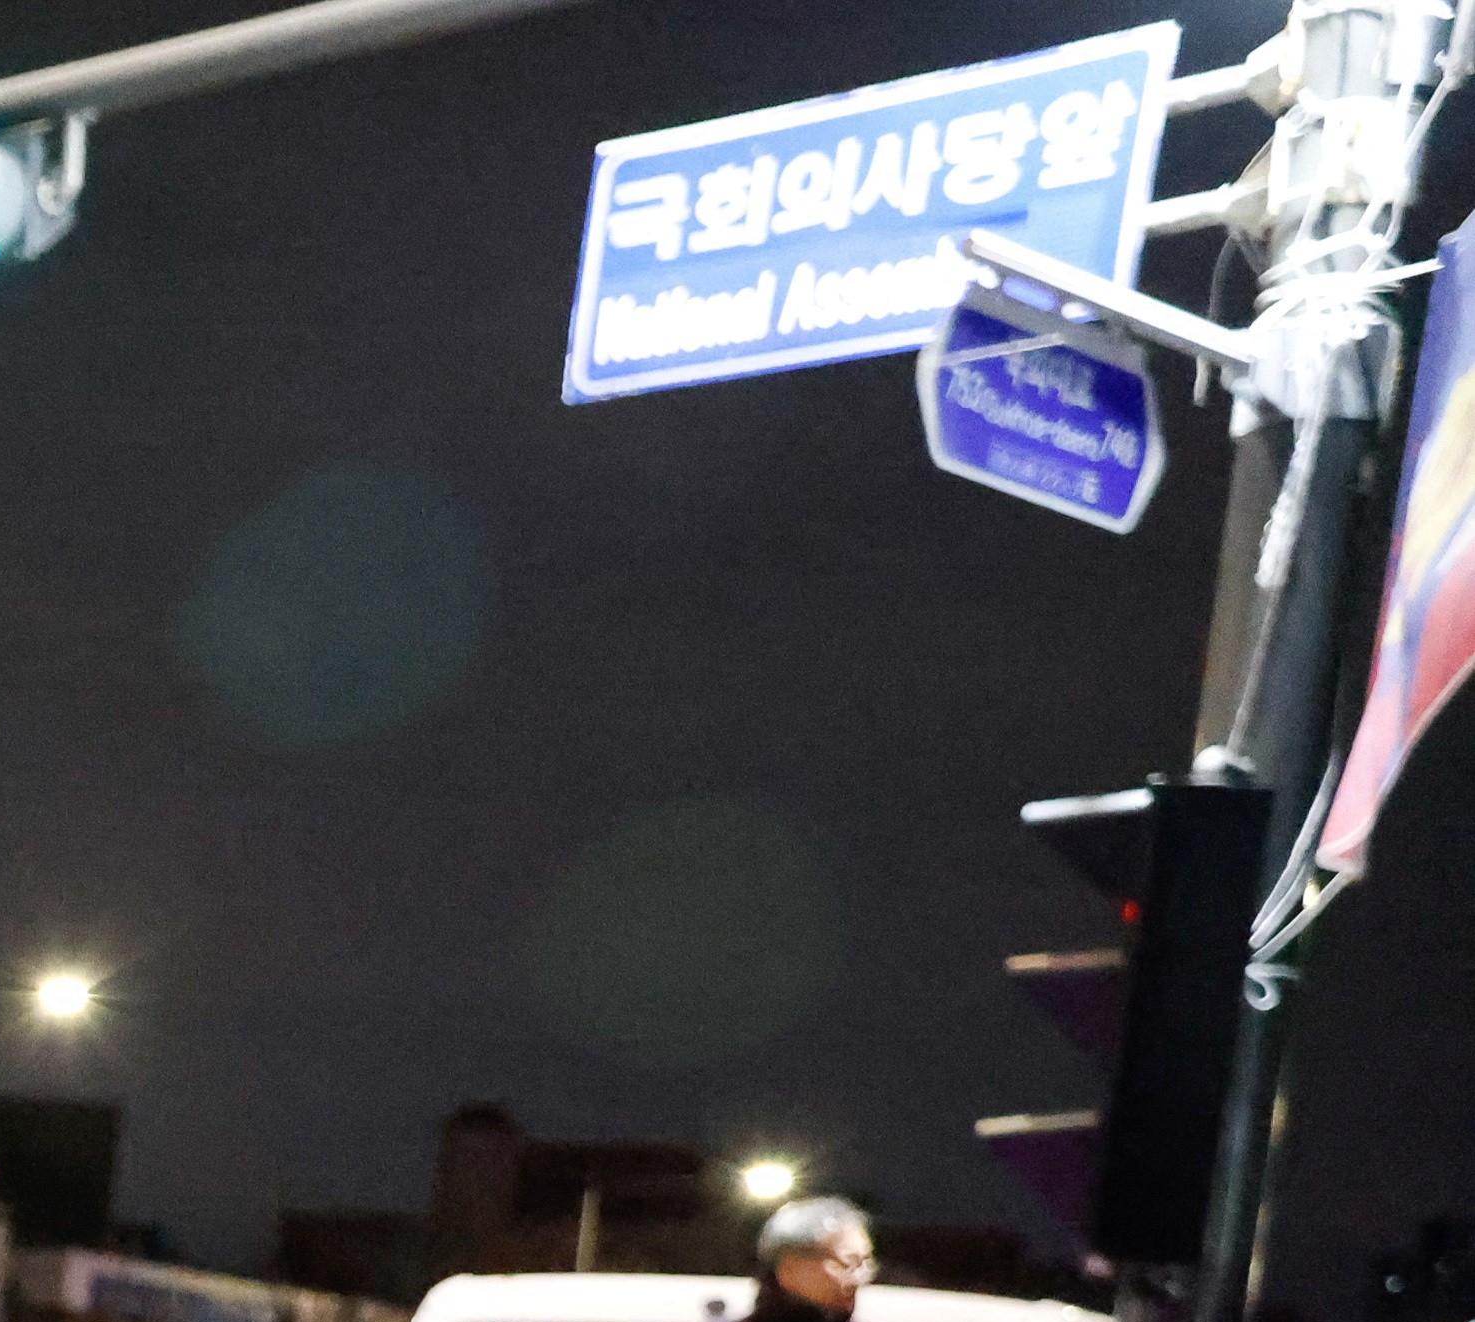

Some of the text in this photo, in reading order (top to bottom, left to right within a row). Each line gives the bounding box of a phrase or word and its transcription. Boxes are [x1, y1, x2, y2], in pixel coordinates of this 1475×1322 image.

[609, 82, 1135, 259] 국회의사당앞
[595, 238, 981, 365] National Assemb
